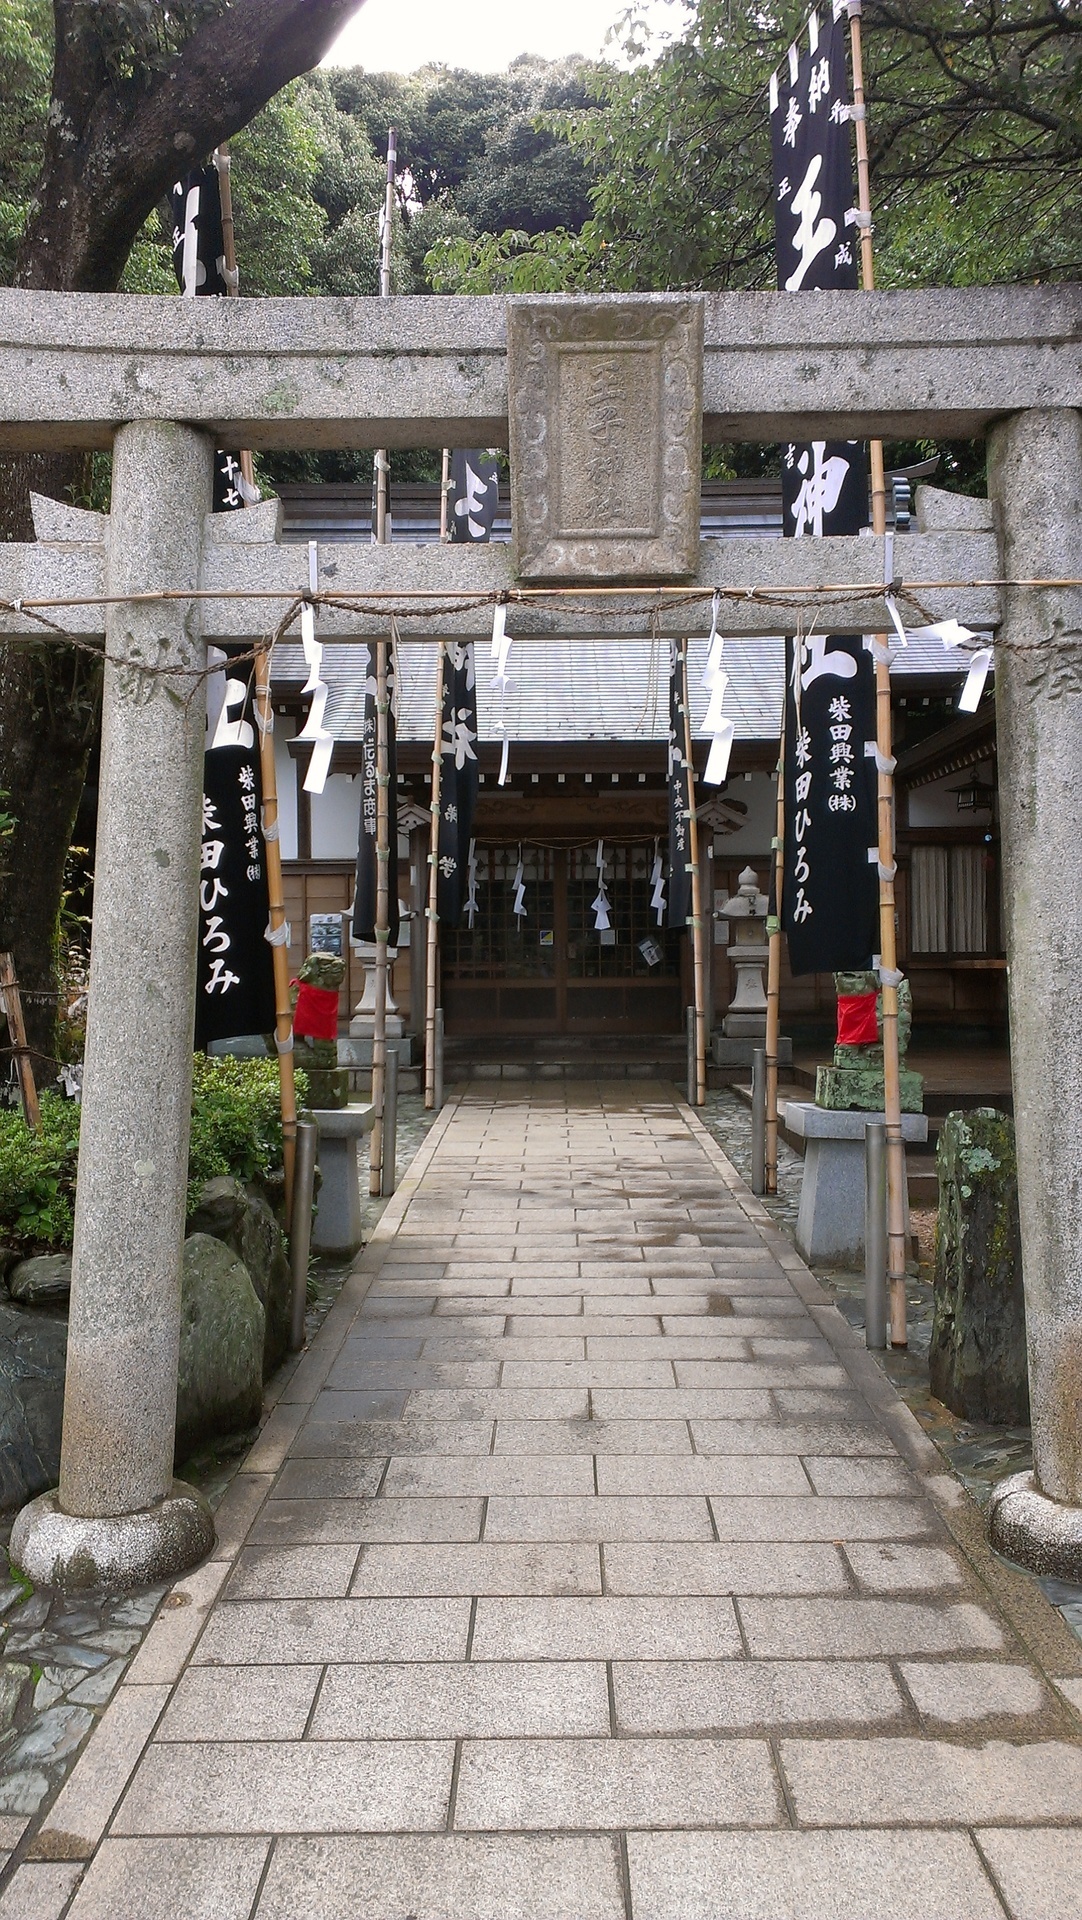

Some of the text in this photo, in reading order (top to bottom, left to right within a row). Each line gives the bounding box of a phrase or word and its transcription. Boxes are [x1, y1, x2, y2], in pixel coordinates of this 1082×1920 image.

[585, 358, 627, 519] 王子神社
[794, 726, 814, 924] 柴田ひろみ
